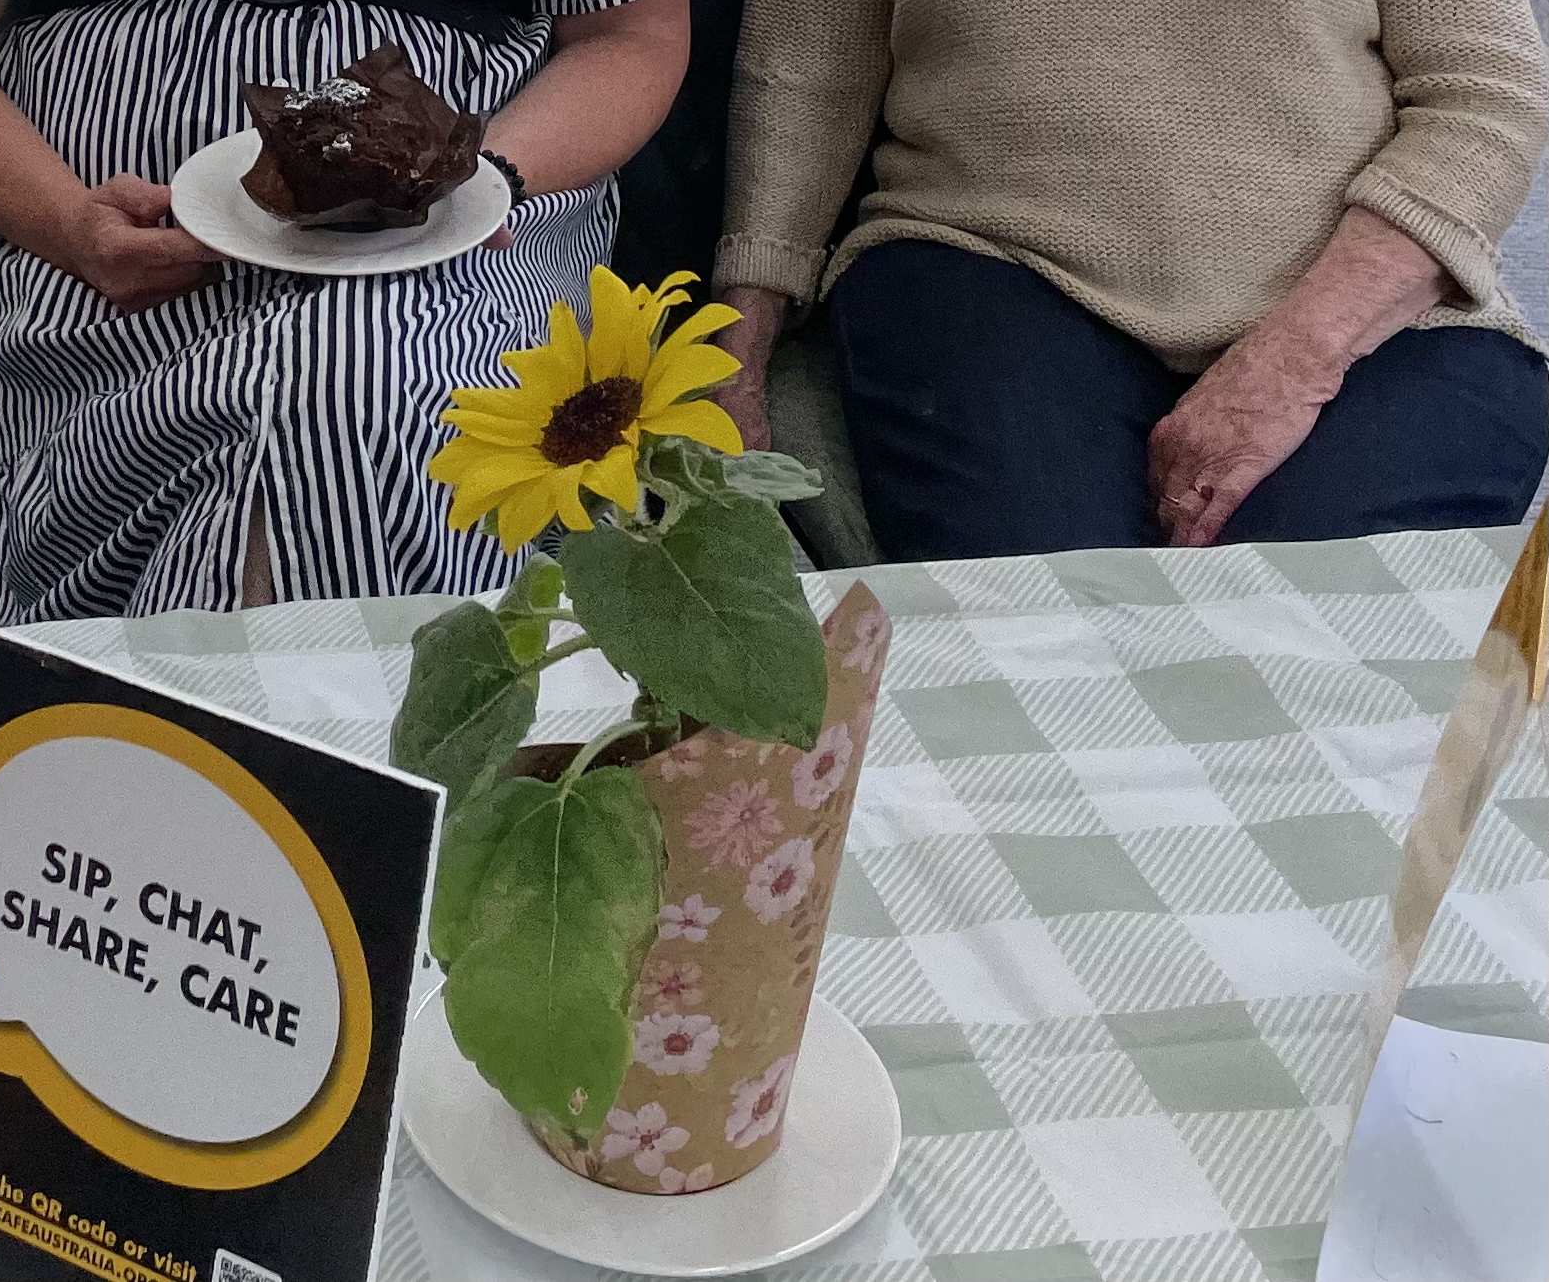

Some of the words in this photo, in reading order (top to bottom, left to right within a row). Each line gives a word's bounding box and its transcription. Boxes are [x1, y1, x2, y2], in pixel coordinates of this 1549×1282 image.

[0, 889, 160, 993] SHARE,
[180, 963, 302, 1048] CARE
[41, 842, 119, 913] SIP,
[138, 882, 268, 975] CHAT,
[30, 1191, 63, 1223] QR
[67, 1219, 117, 1248] code
[123, 1239, 148, 1260] or
[153, 1251, 198, 1282] visit
